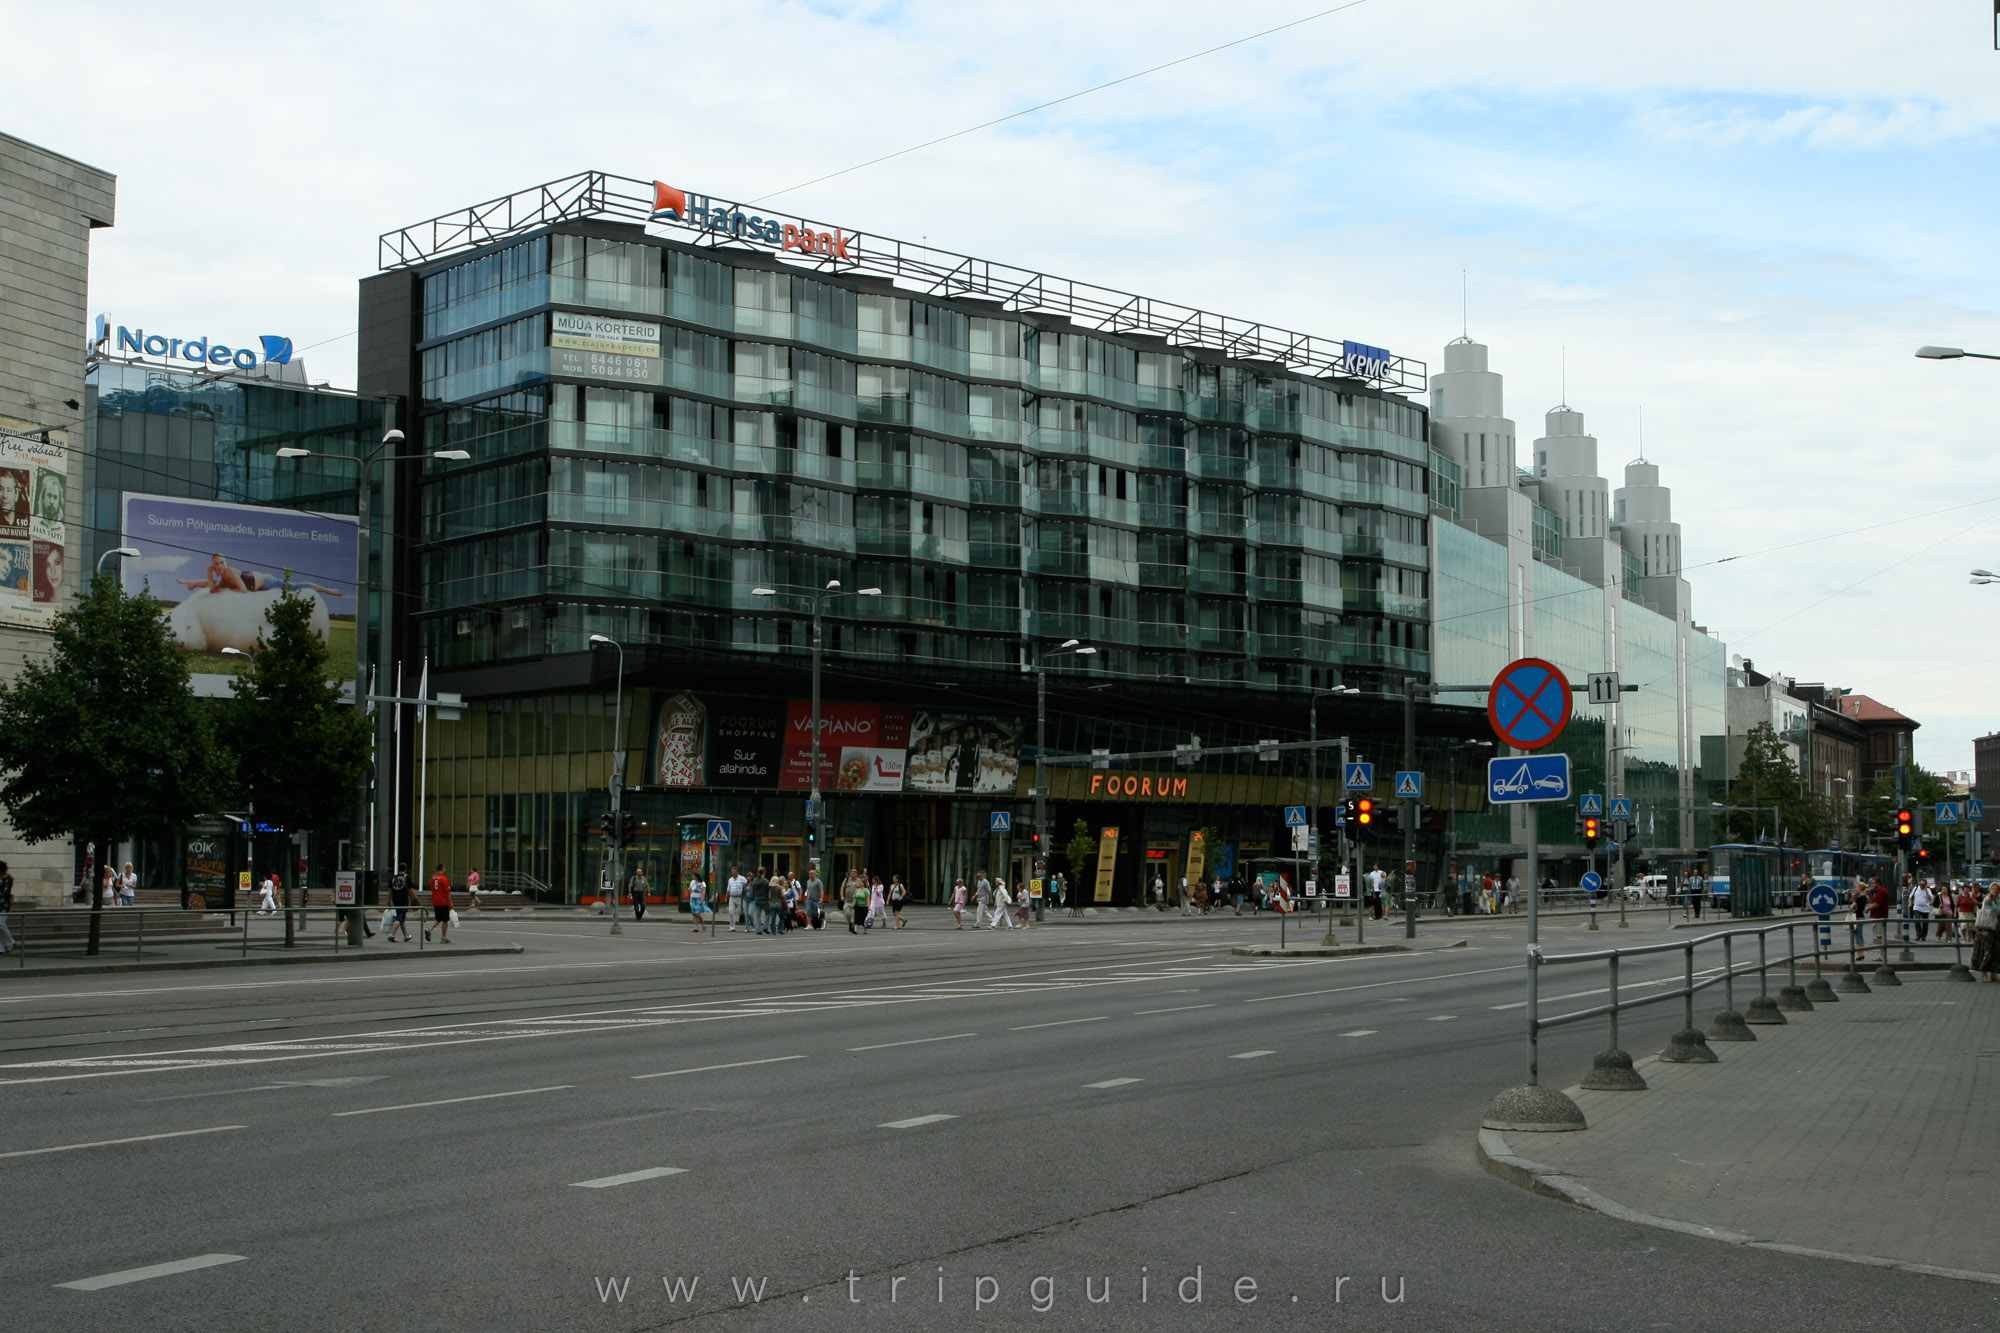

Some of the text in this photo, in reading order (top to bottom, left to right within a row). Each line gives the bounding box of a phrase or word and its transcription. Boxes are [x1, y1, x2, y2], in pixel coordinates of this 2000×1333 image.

[687, 193, 850, 260] Hansapank
[558, 317, 655, 338] MÜÜA KORTERID
[117, 325, 257, 370] Nordea
[563, 354, 648, 368] TEL. 6446 061
[1345, 352, 1390, 379] KPMG
[591, 365, 622, 376] 5084
[626, 368, 648, 379] 930
[147, 513, 340, 543] Suurim Põhjamaades, paindlikem Eestis
[14, 548, 29, 560] THE
[13, 559, 29, 570] SUN
[682, 718, 695, 726] ALE
[719, 715, 777, 729] FOORUM
[719, 729, 776, 738] SHOPPING
[671, 748, 682, 760] ALE
[733, 749, 757, 760] Suur
[681, 759, 694, 771] ALE
[719, 763, 767, 775] allahindlus
[679, 768, 692, 779] ALE
[1090, 774, 1188, 797] FOORUM
[434, 879, 439, 890] 8
